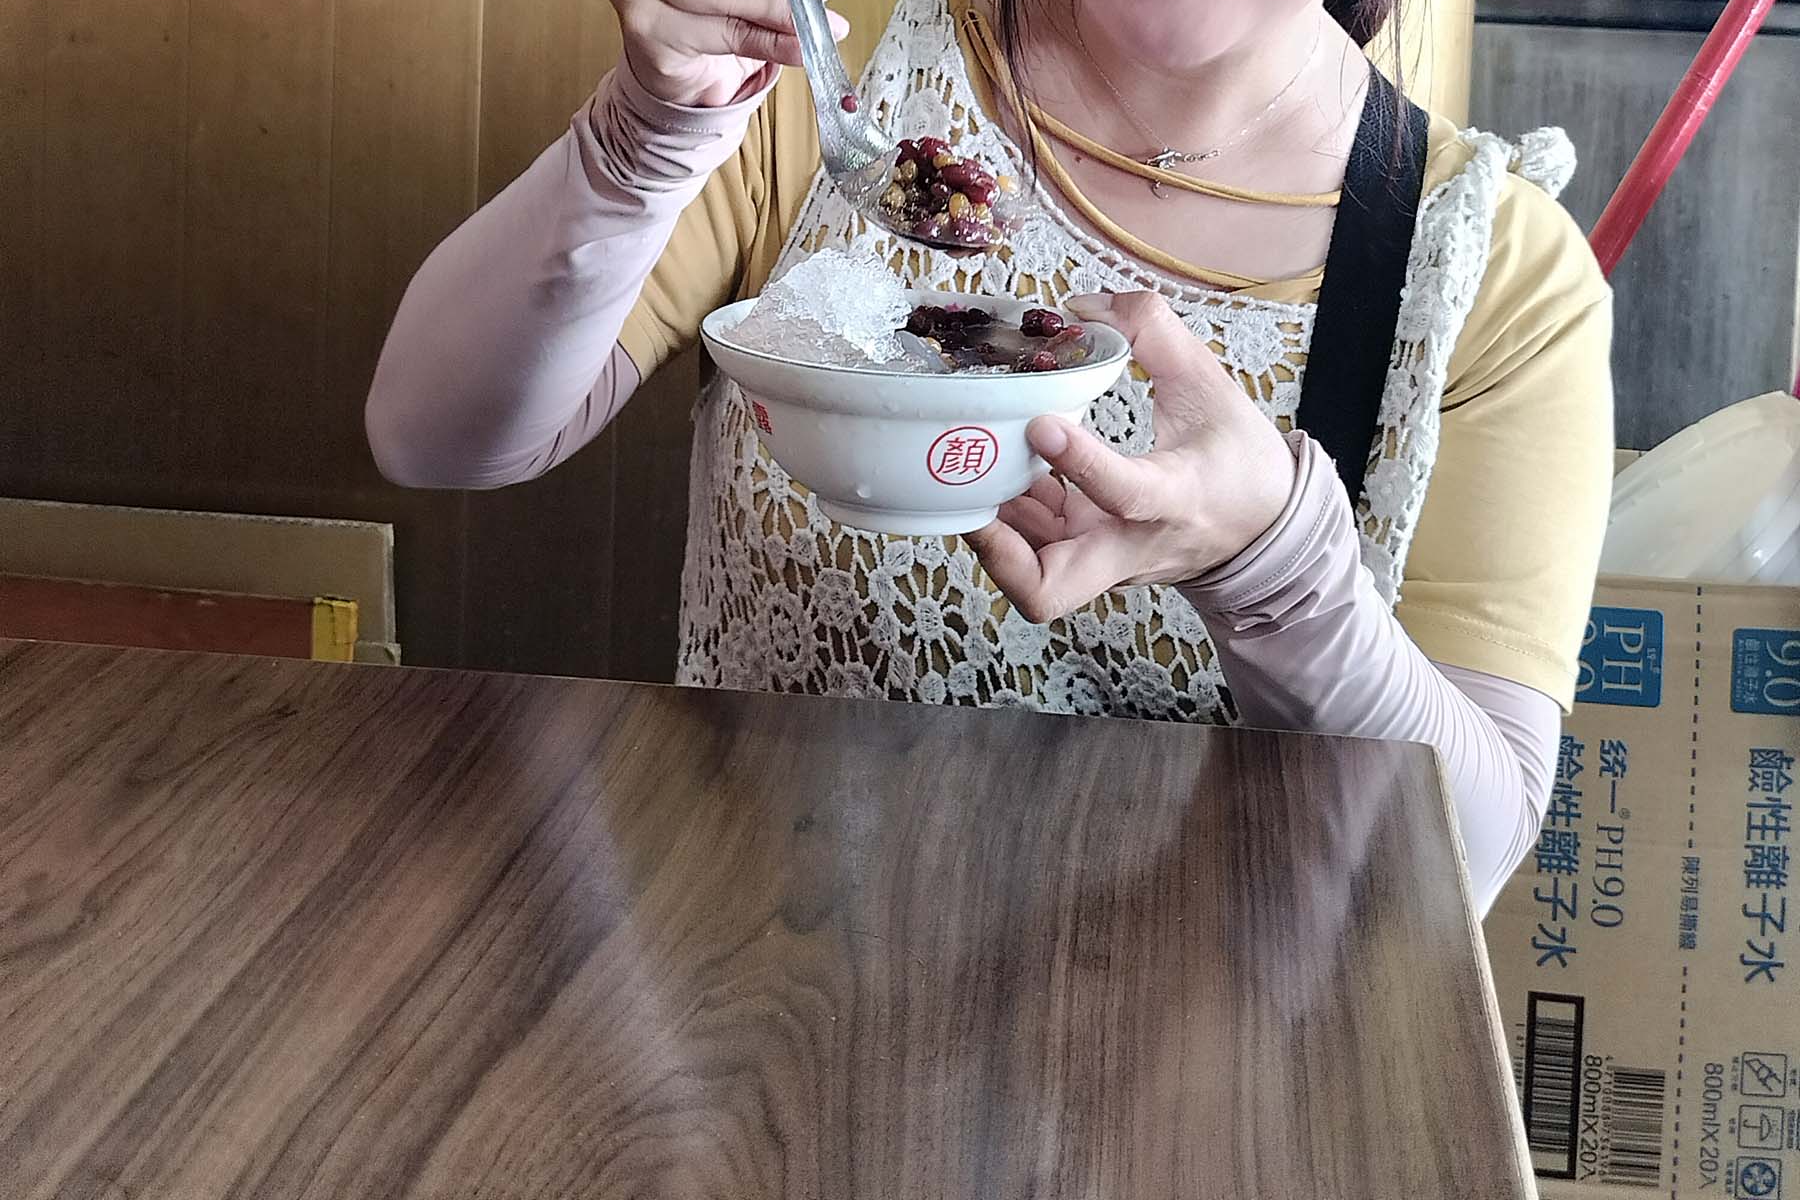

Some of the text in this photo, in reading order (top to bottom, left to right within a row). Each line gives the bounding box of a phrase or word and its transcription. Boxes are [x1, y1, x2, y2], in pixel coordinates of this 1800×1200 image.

[1601, 621, 1645, 696] PH
[1762, 639, 1800, 708] 9.0
[1590, 822, 1627, 929] PH9.0
[1738, 746, 1798, 983] 鹼性離子水
